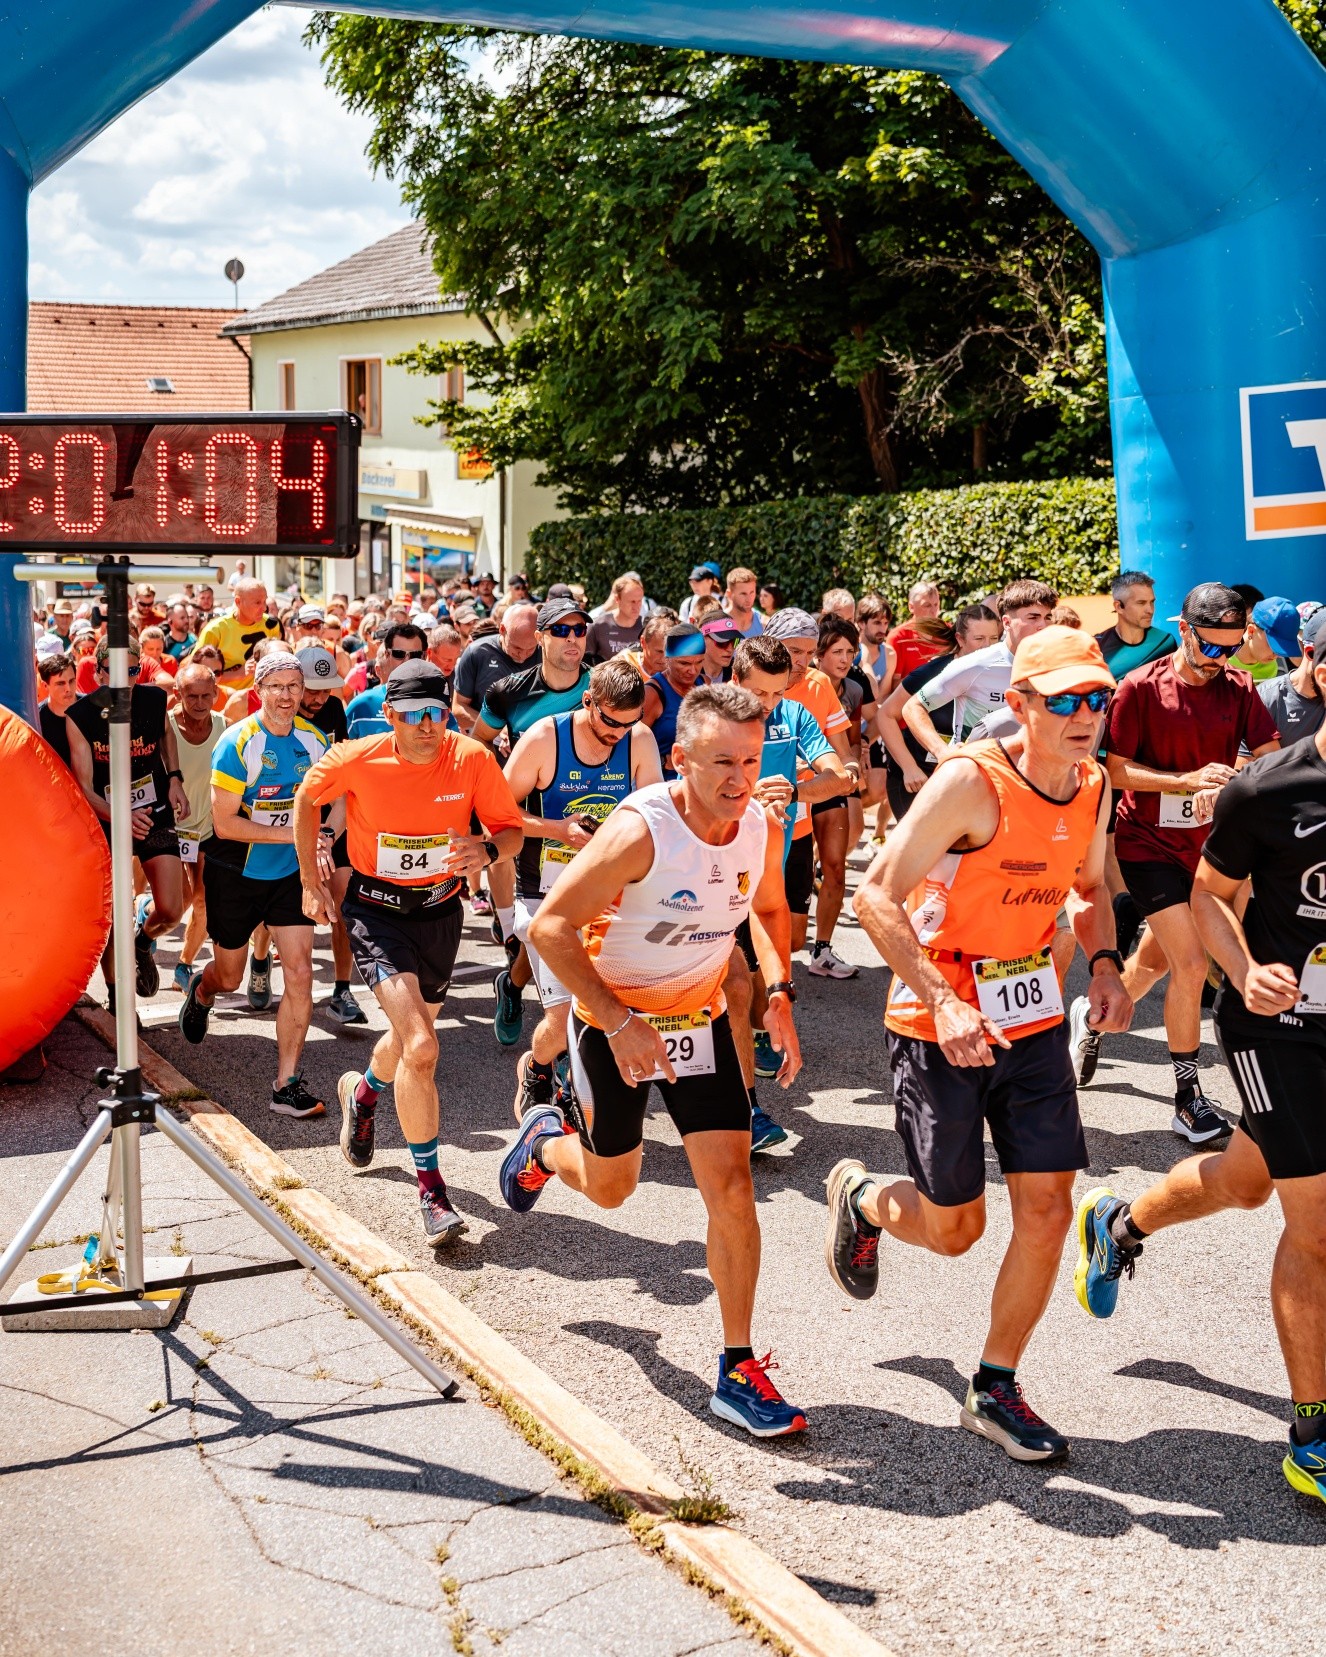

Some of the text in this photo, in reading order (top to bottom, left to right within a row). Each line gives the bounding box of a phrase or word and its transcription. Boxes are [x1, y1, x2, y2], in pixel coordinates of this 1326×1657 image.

[442, 793, 465, 801] TERREX
[270, 813, 289, 826] 79
[400, 853, 429, 870] 84
[359, 885, 401, 905] LEKI
[657, 899, 704, 912] Adelholzener
[997, 954, 1033, 969] FRISEUR
[1006, 966, 1029, 976] NEBL
[997, 977, 1043, 1012] 108
[649, 1014, 690, 1024] FRISEUR
[657, 1023, 682, 1031] NEBL
